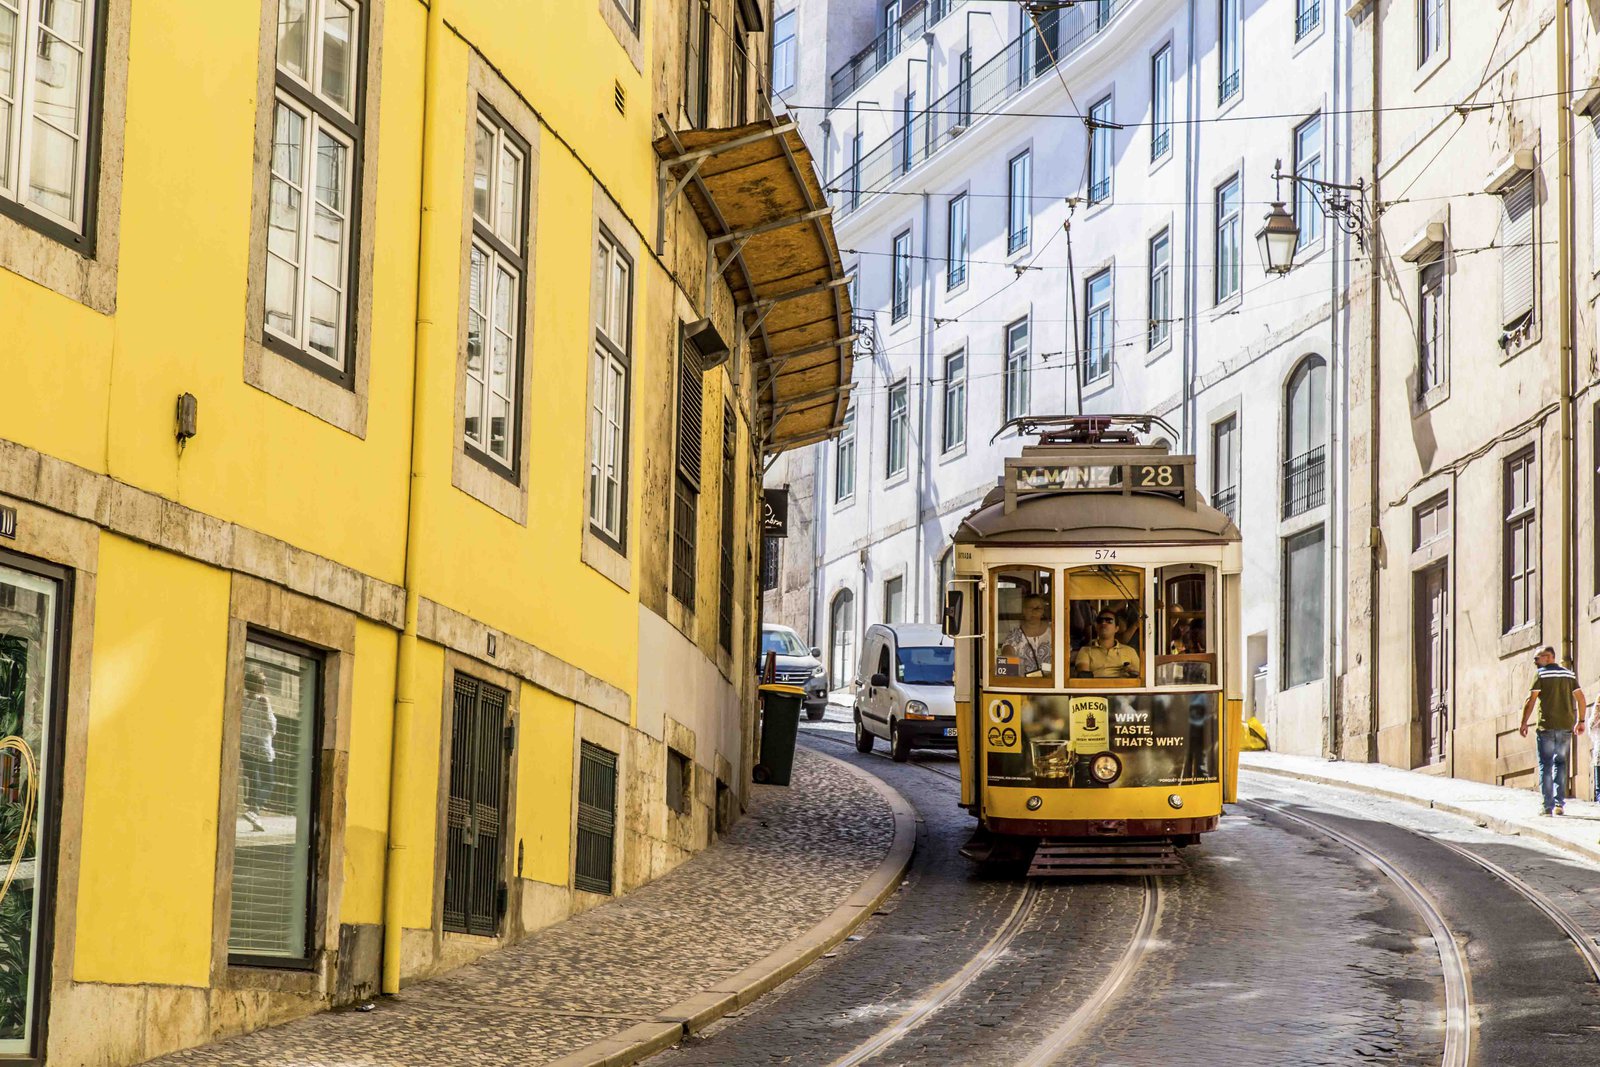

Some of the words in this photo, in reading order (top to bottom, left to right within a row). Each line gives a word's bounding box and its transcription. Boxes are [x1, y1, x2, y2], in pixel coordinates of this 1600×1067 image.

[1141, 466, 1173, 486] 28
[1, 509, 13, 535] 10
[1095, 549, 1116, 560] 574
[997, 667, 1007, 675] 02
[1072, 701, 1107, 713] JAMESON
[1114, 713, 1148, 722] WHY?
[1114, 725, 1153, 735] TASTE,
[1114, 737, 1153, 746] THAT'S
